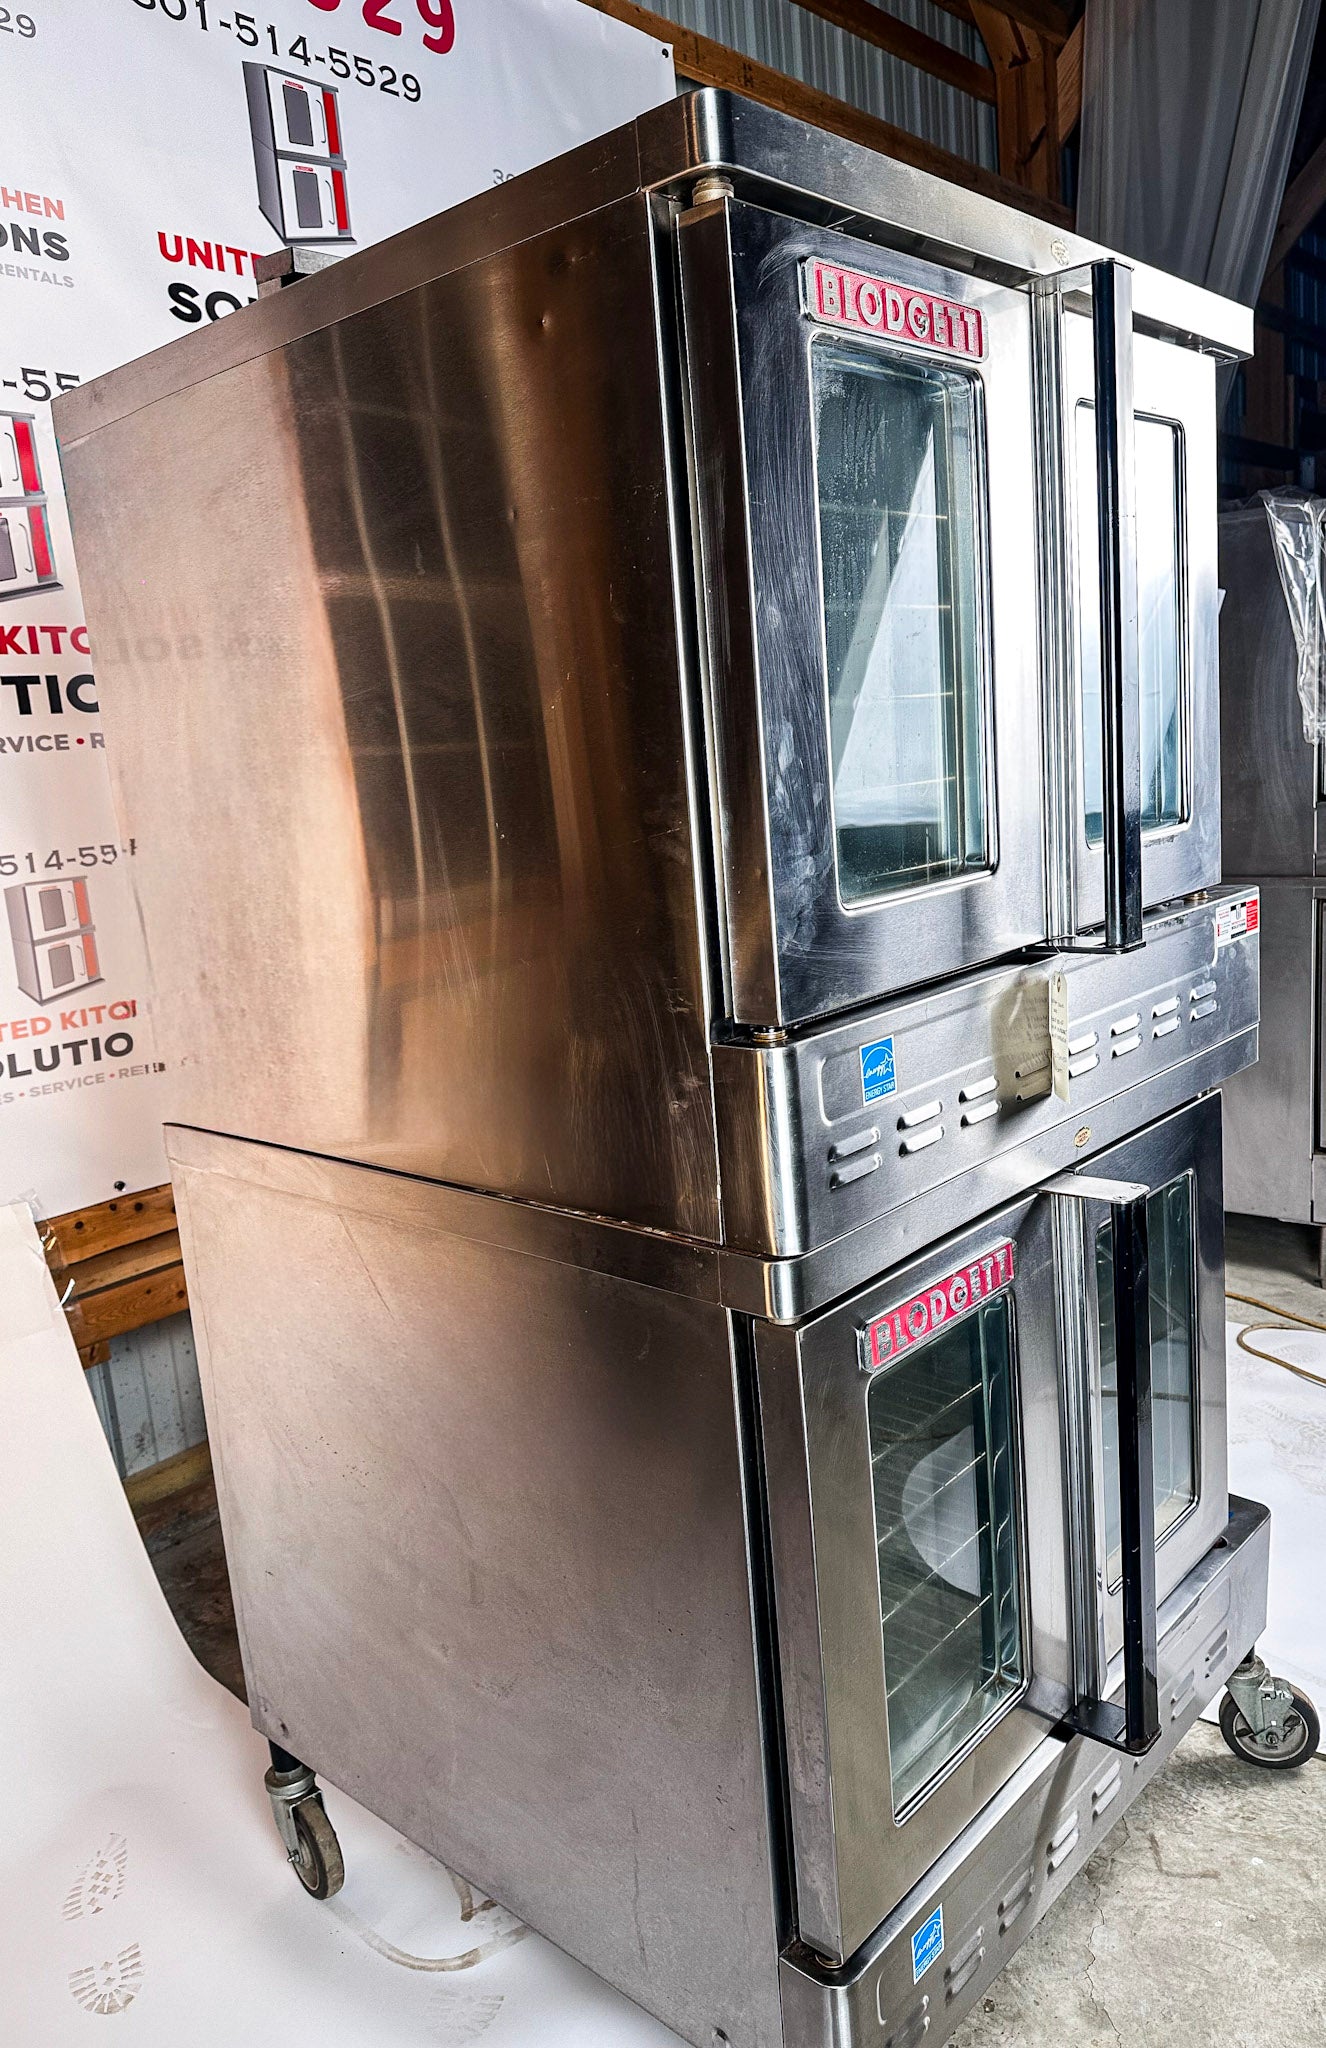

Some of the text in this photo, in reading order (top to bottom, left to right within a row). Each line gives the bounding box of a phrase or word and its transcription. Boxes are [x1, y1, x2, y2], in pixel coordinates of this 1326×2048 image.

[131, 0, 422, 103] 01-514-5529
[0, 222, 70, 261] NS
[168, 282, 257, 323] SO
[817, 268, 979, 351] BLODGETT
[0, 1032, 134, 1079] LUTIO
[30, 1072, 105, 1098] SERVICE
[875, 1248, 1007, 1361] BLODGETT
